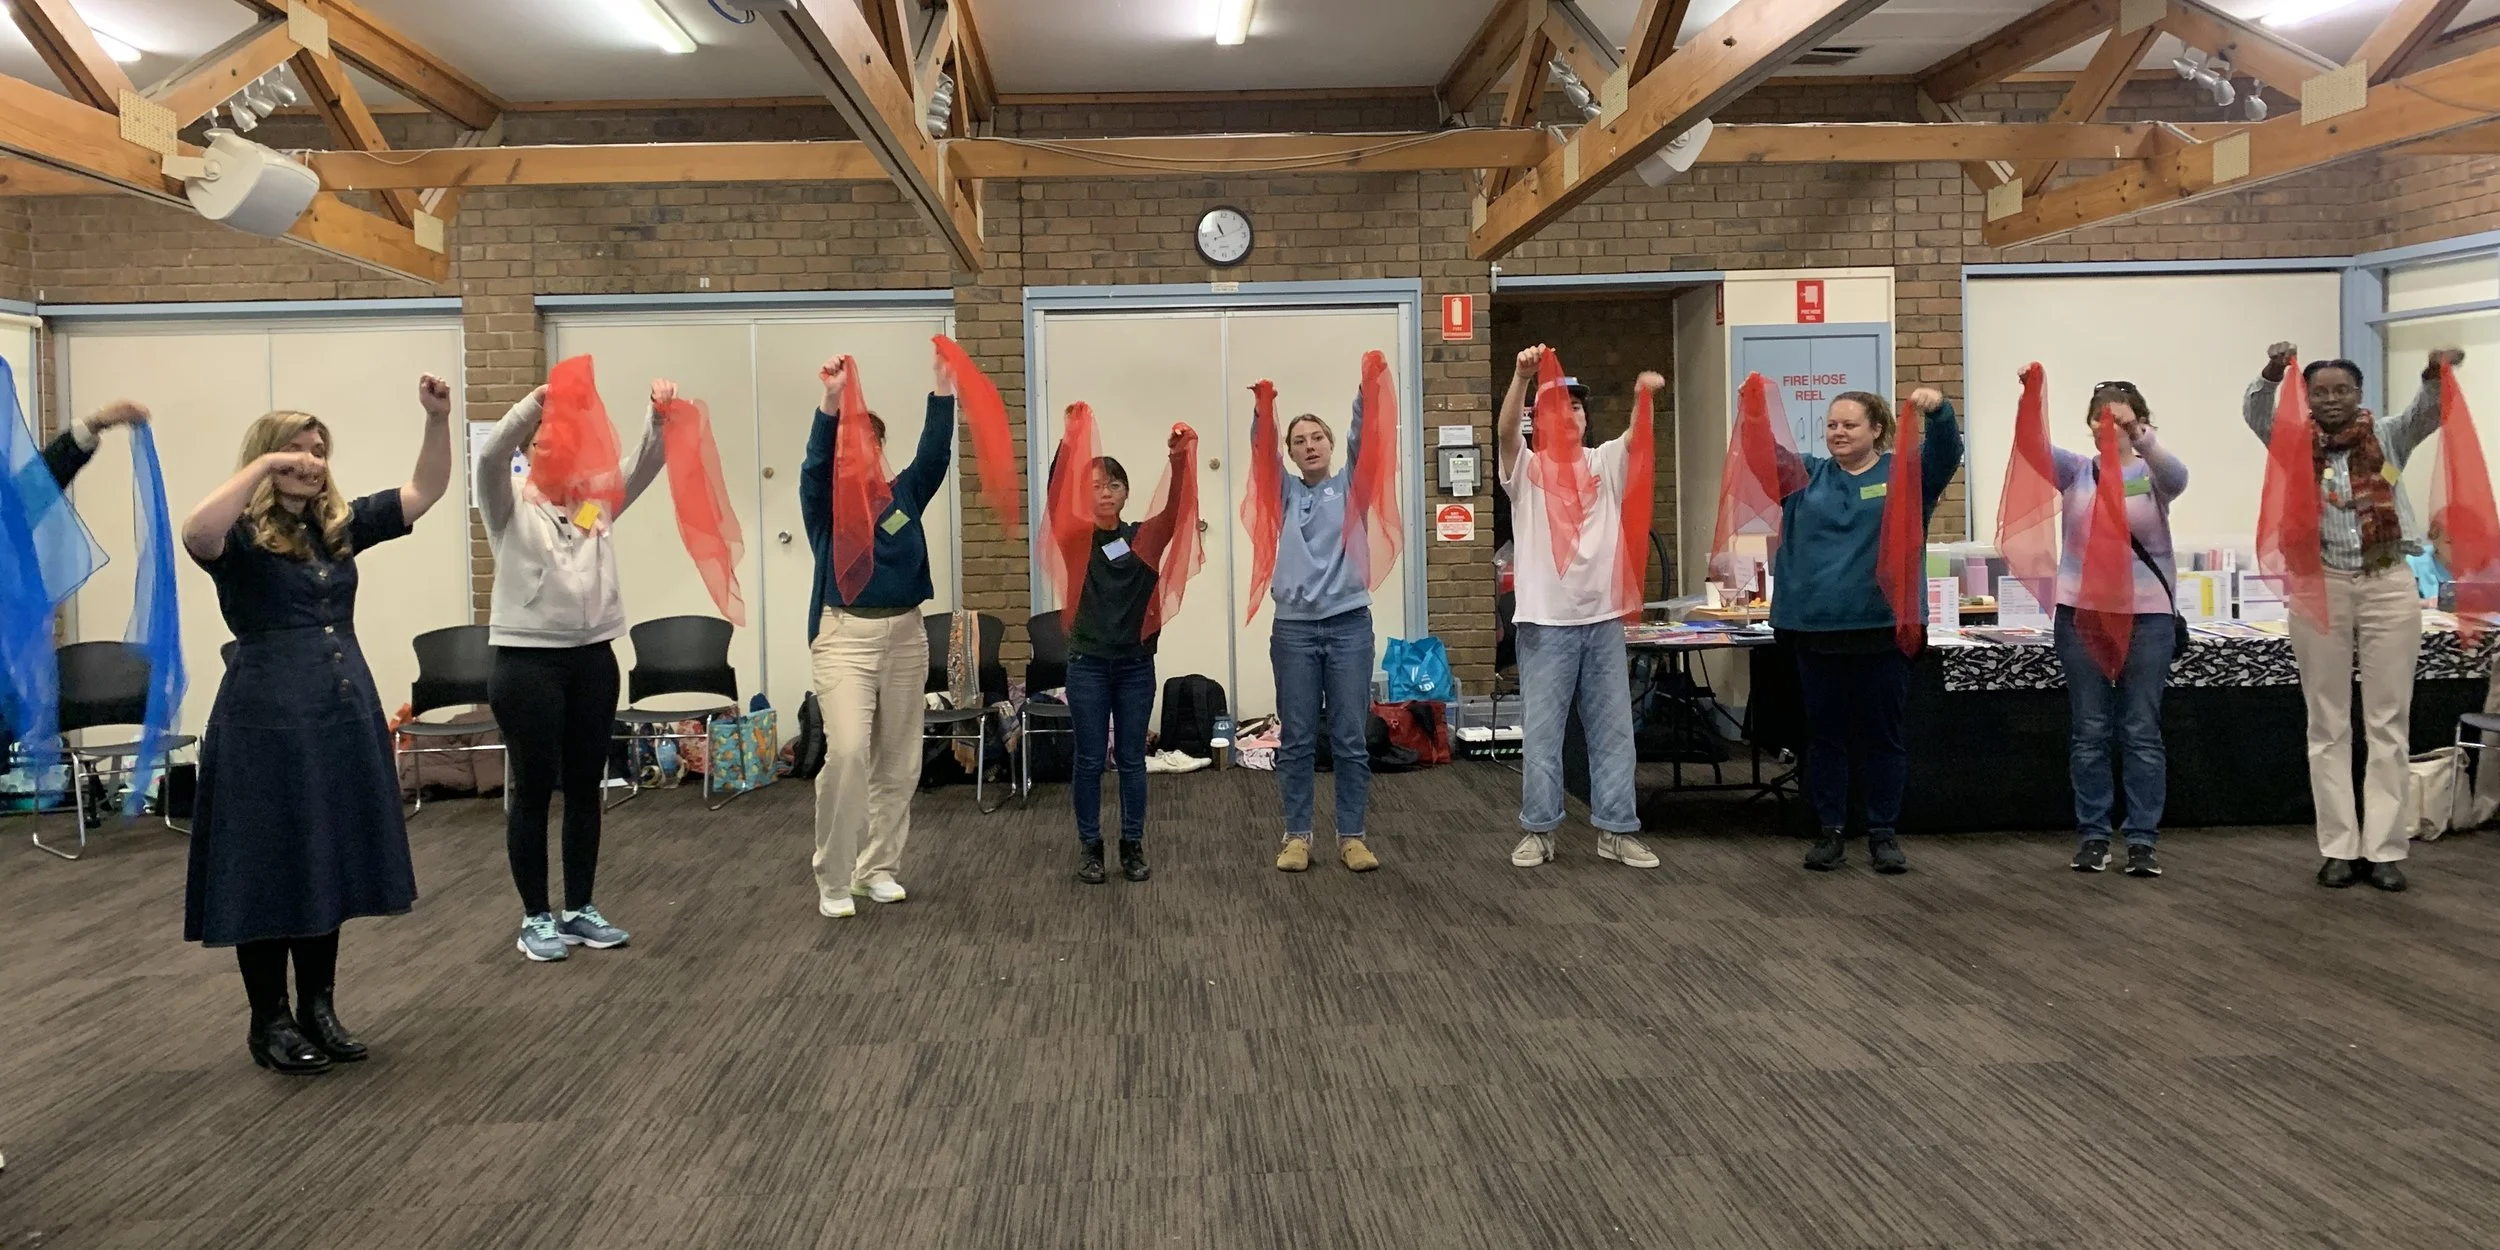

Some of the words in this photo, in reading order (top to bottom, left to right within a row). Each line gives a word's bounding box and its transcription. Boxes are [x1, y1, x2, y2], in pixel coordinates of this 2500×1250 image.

[1783, 375, 1809, 387] FIRE
[1812, 373, 1847, 386] HOSE
[1795, 390, 1826, 401] REEL
